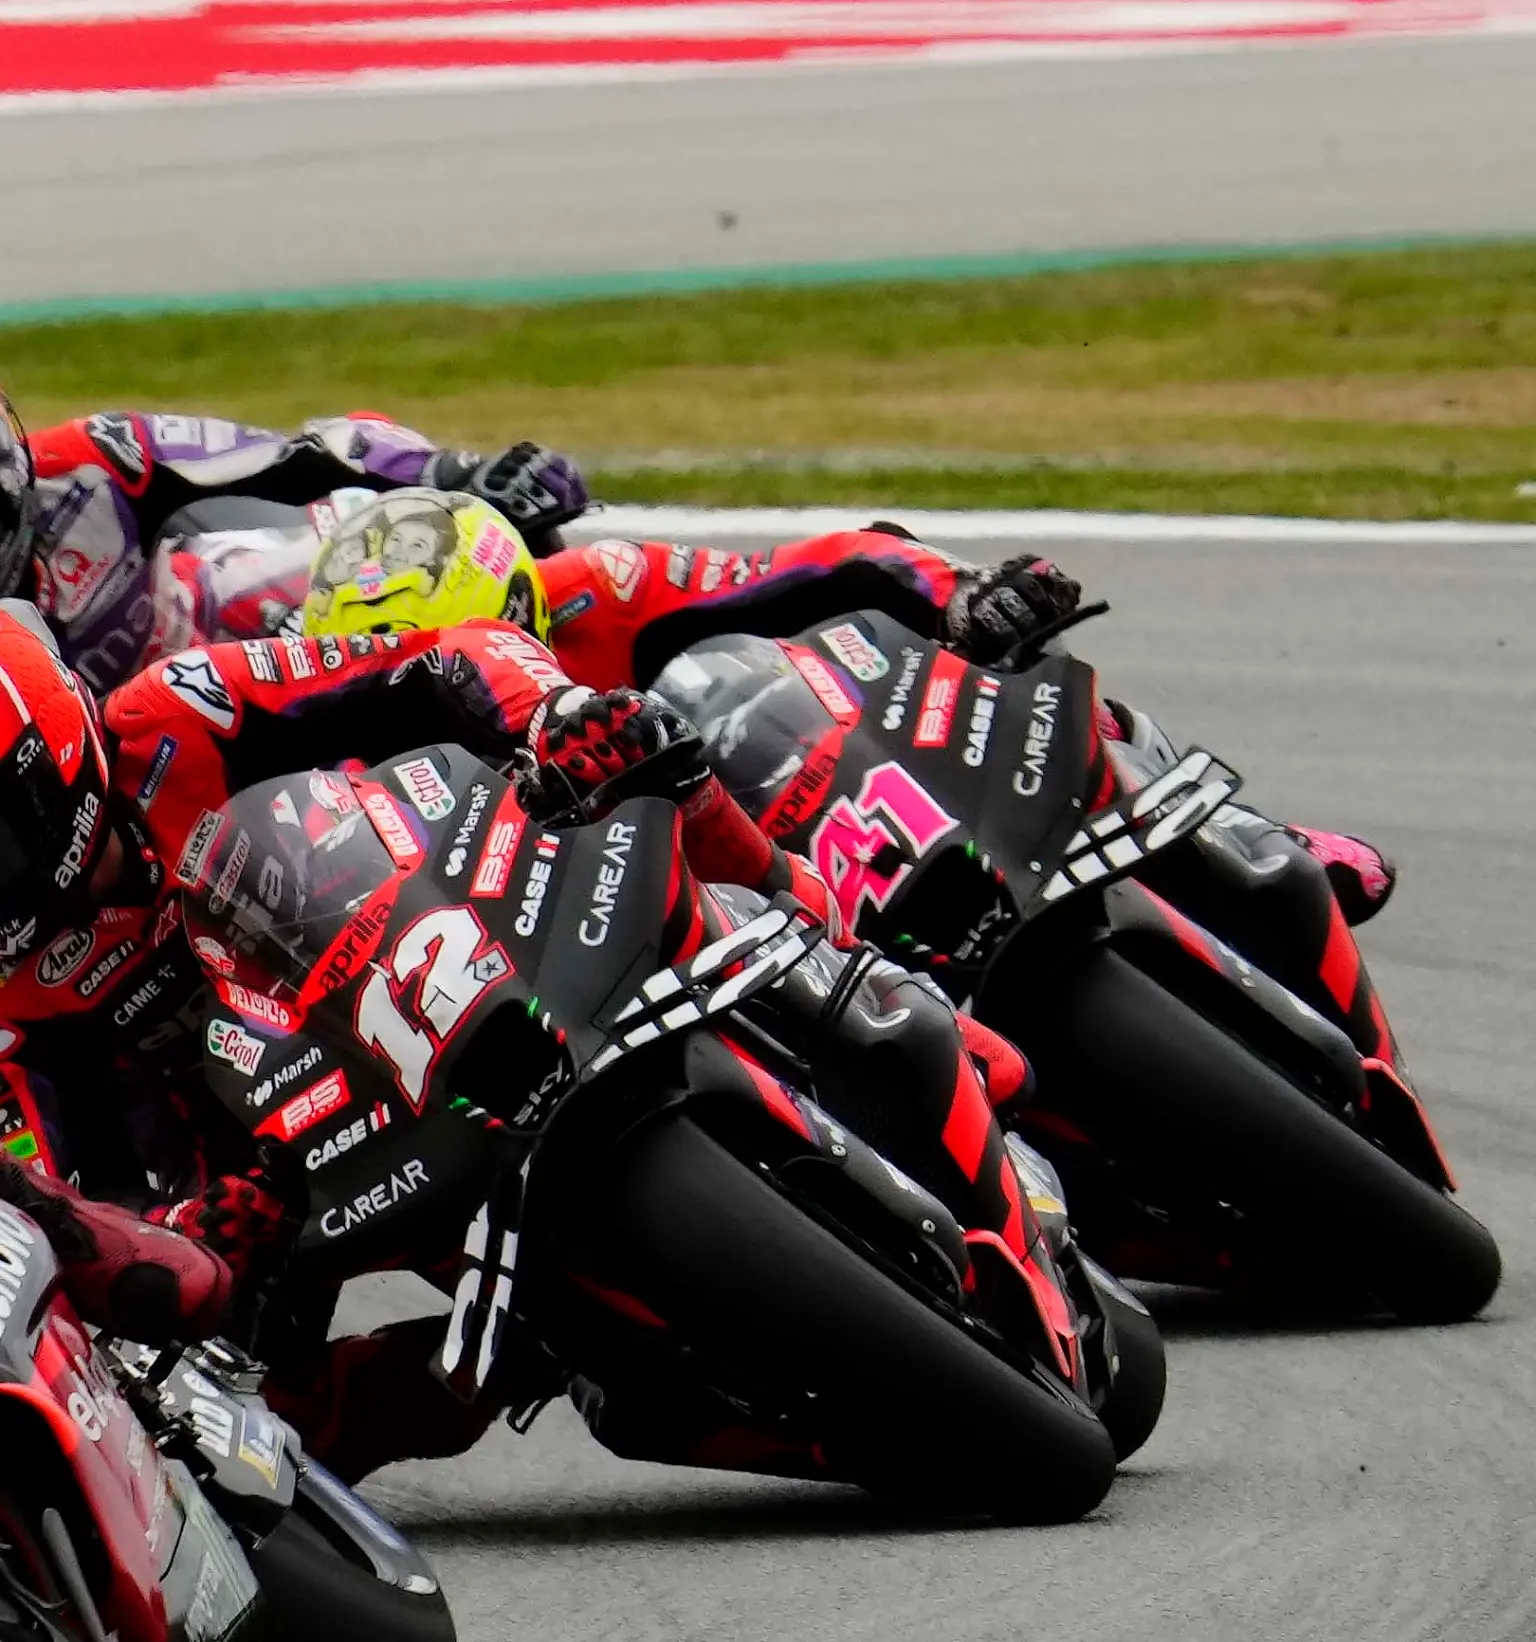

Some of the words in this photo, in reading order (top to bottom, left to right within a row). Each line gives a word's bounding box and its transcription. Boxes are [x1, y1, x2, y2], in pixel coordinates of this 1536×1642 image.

[964, 697, 996, 768] CASE
[1012, 682, 1063, 797] CAREAR
[55, 792, 99, 889] aprilia
[455, 787, 492, 845] Marsh
[810, 760, 961, 932] 41
[475, 822, 515, 892] BS
[578, 821, 637, 947] CAREAR
[515, 861, 552, 937] CASE
[43, 929, 92, 983] Arai
[319, 902, 393, 993] aprilia
[354, 903, 517, 1117] 12
[274, 1047, 323, 1090] Marsh
[281, 1074, 341, 1128] BS
[305, 1118, 368, 1171] CASE
[321, 1159, 431, 1238] CAREAR
